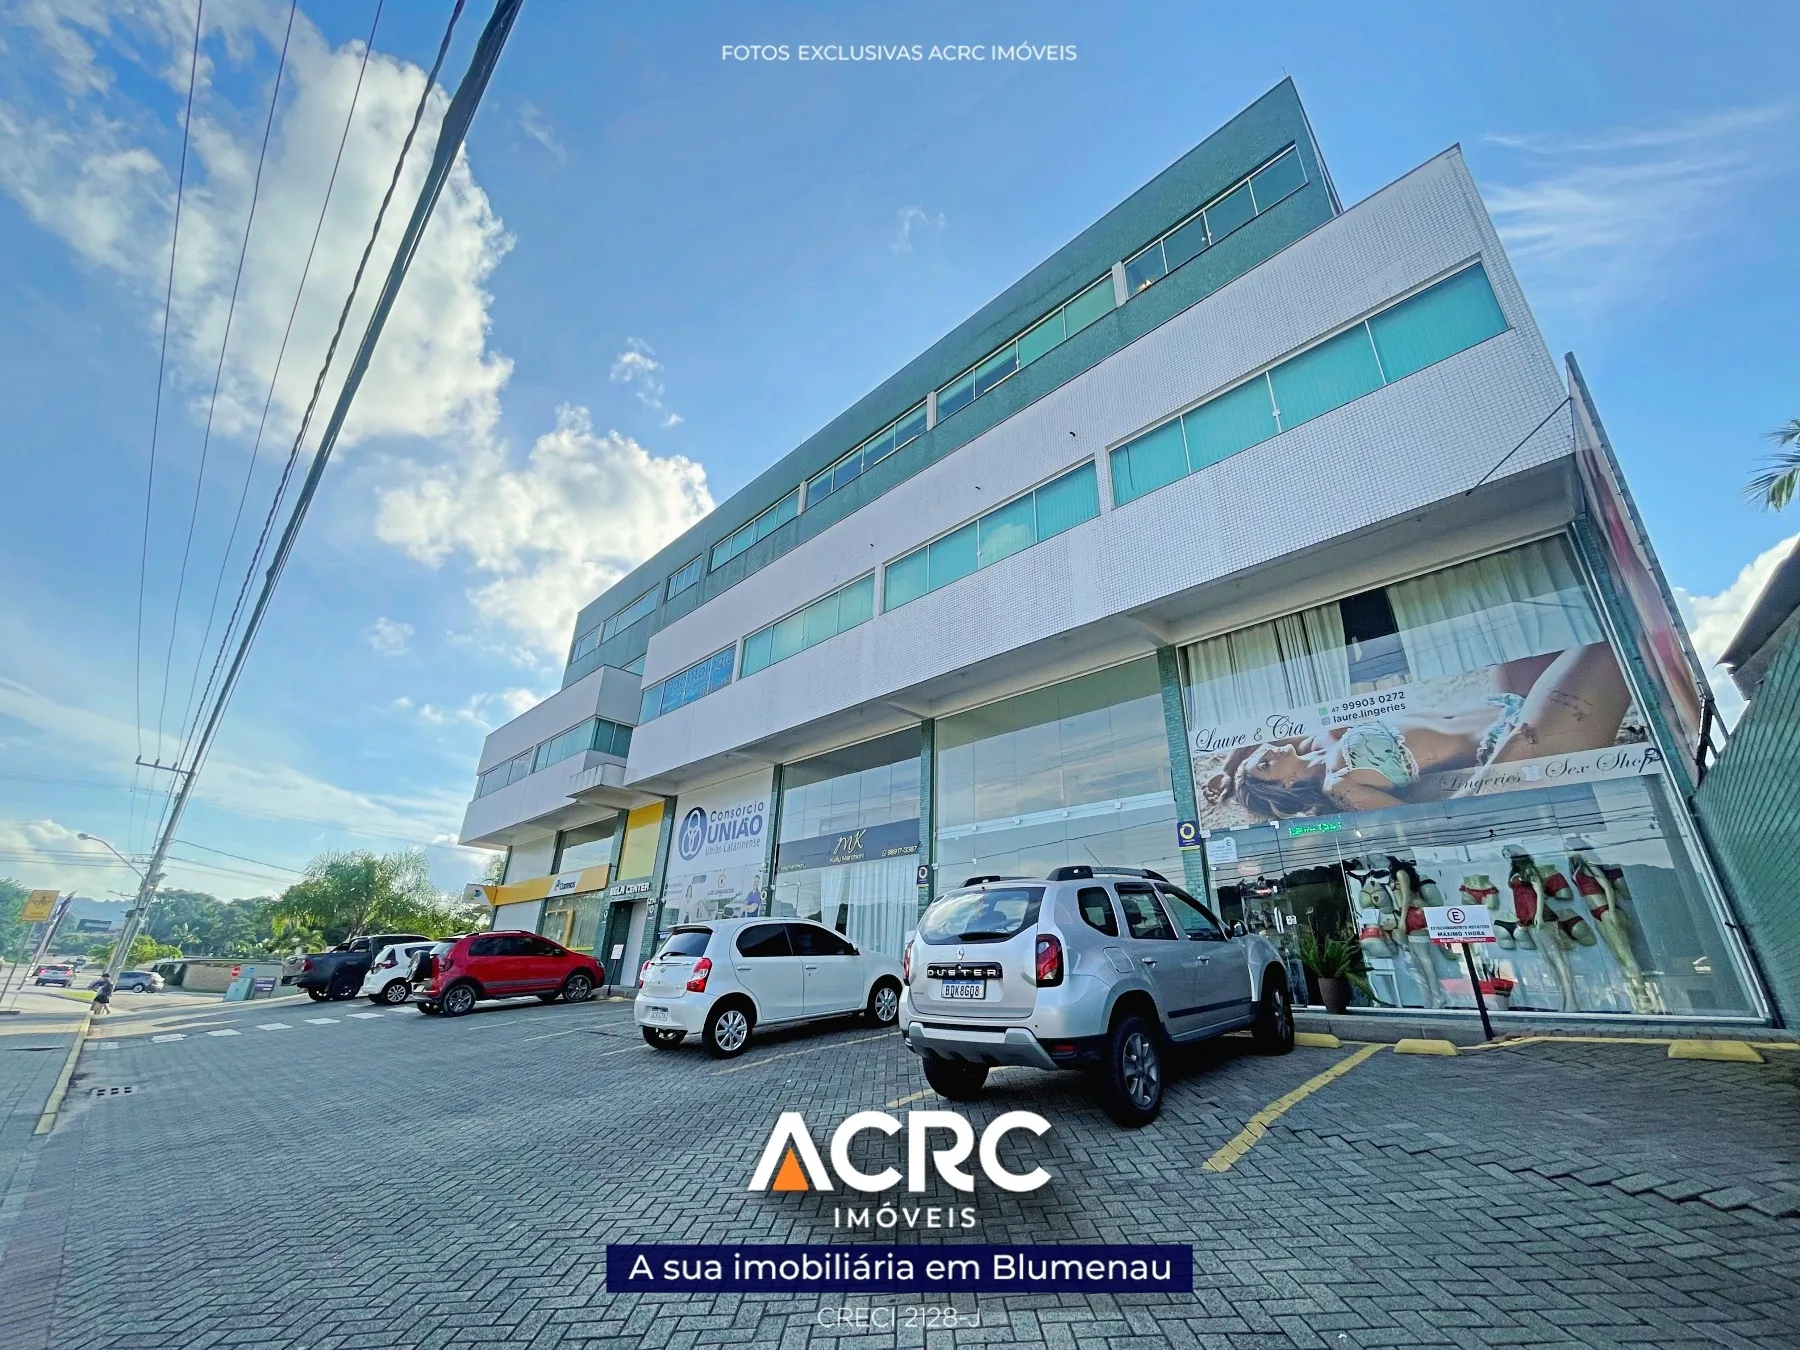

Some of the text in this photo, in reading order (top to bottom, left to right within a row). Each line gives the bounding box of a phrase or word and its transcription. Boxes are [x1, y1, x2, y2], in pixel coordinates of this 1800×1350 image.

[1342, 696, 1376, 711] 99903
[1378, 691, 1406, 704] 0272
[1333, 702, 1406, 724] laure.lingeries
[1194, 714, 1306, 753] Laure & Cia
[1545, 747, 1658, 778] Sex Shop
[1438, 771, 1521, 795] Lingeries
[710, 801, 764, 823] Consórcio
[707, 815, 763, 844] UNIÃO
[626, 882, 650, 894] CENTER
[1452, 911, 1461, 921] E
